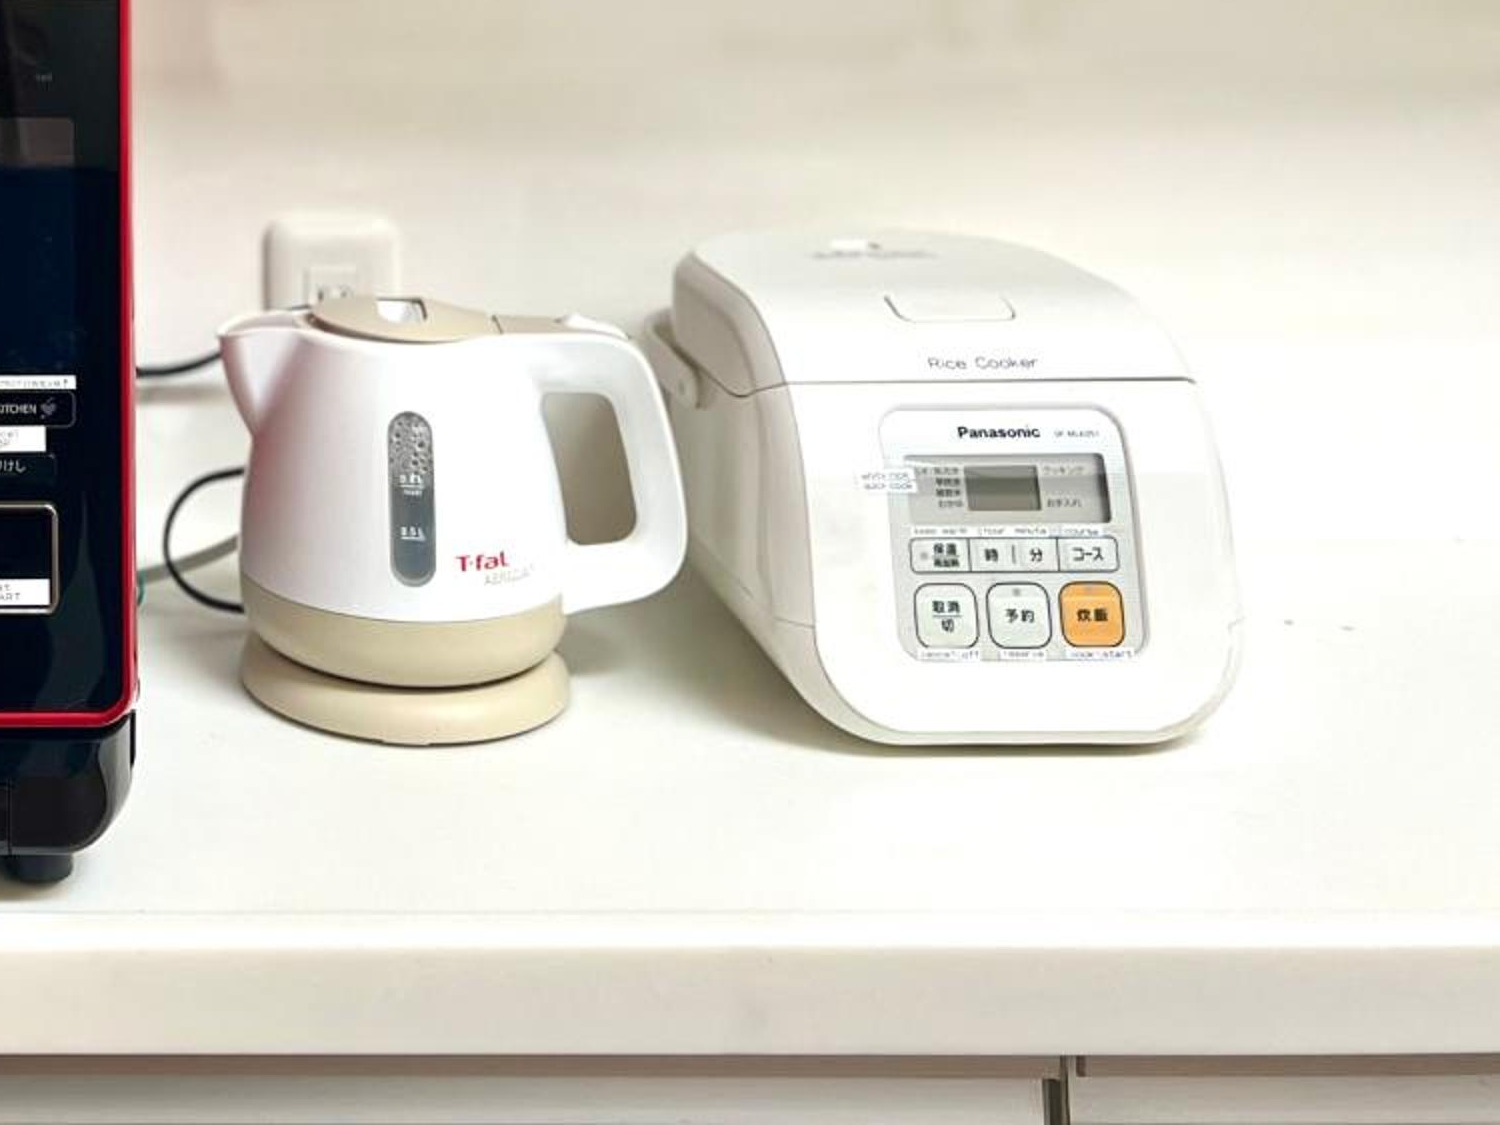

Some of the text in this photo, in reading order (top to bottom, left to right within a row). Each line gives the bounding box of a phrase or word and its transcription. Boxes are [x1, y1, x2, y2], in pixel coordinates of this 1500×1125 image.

[927, 356, 1039, 370] Rice Cooker
[957, 425, 1041, 439] Panasonic
[455, 550, 510, 572] T-fal
[1029, 547, 1043, 562] 分
[1071, 546, 1104, 562] コース
[1005, 608, 1035, 623] 予約
[1076, 608, 1109, 623] 炊飯
